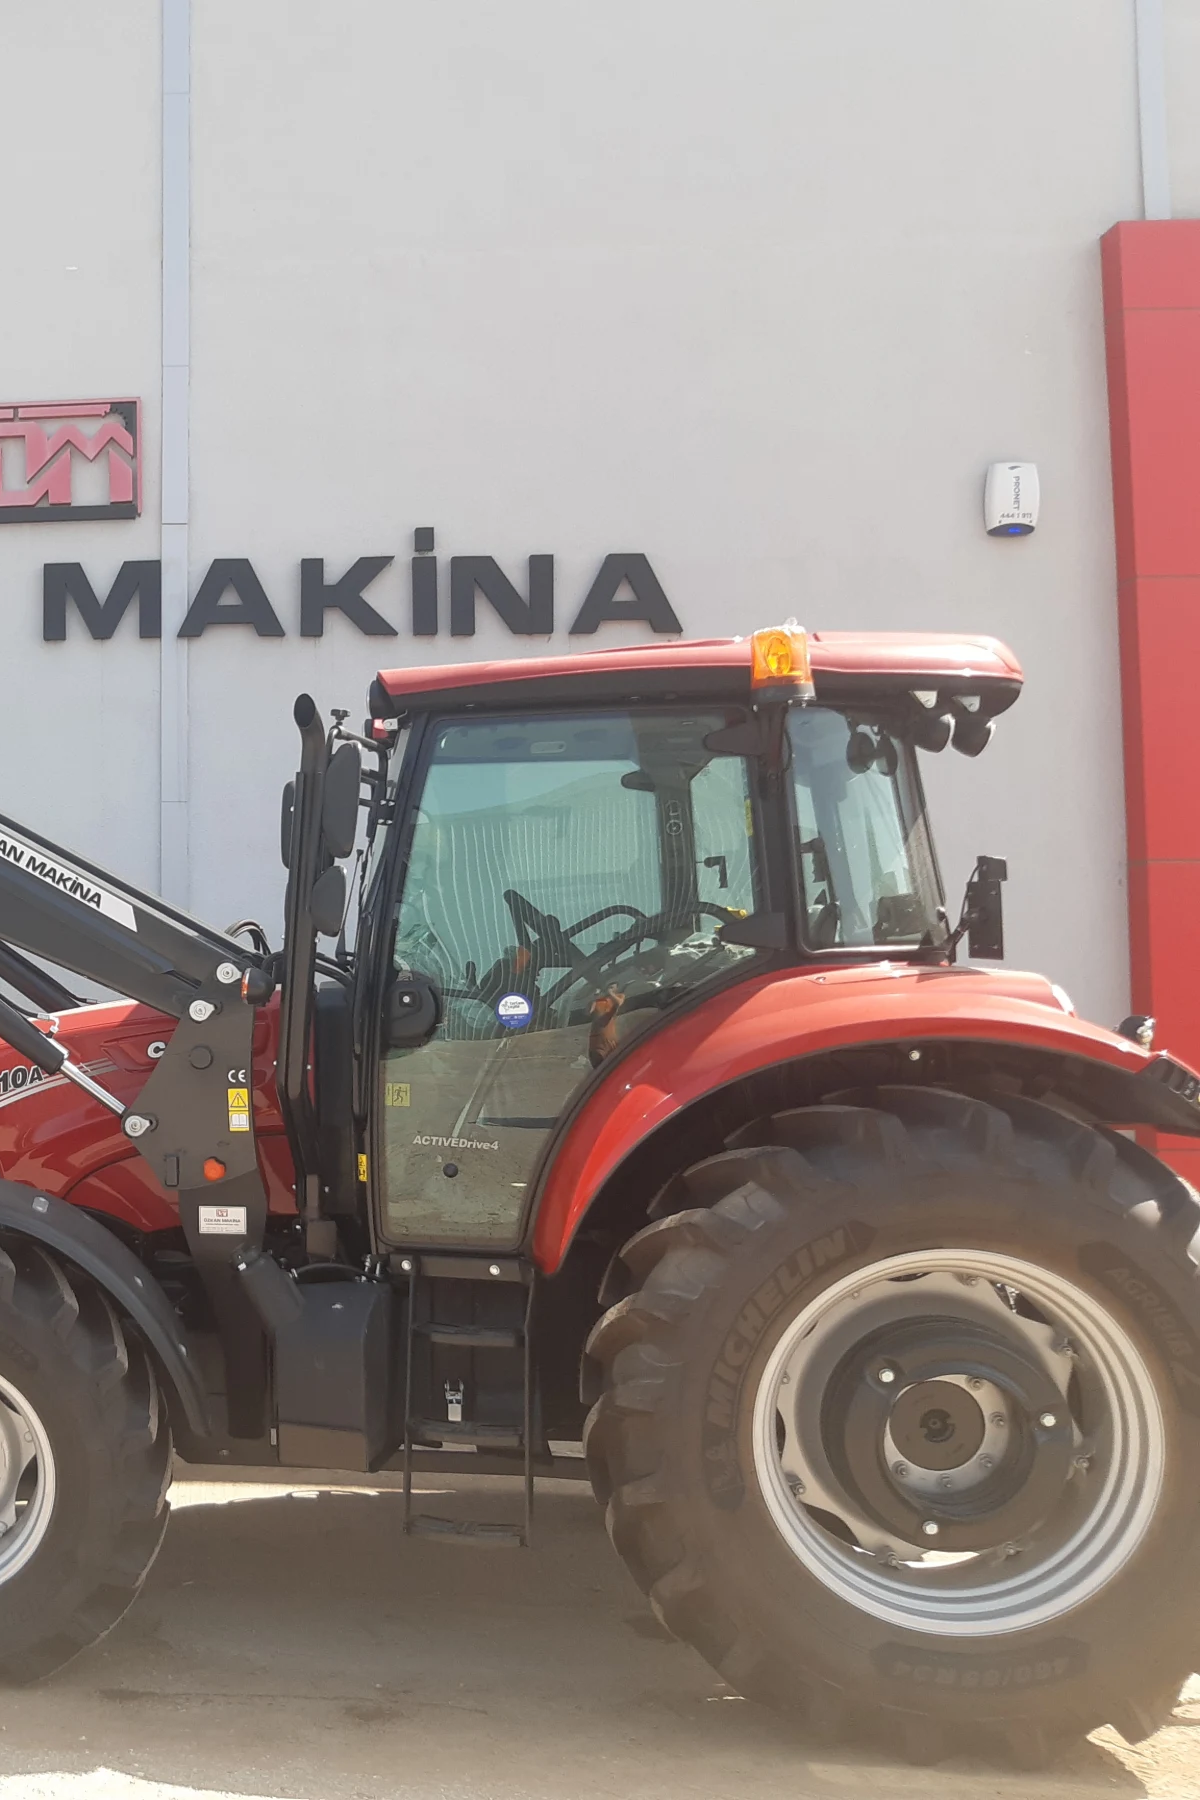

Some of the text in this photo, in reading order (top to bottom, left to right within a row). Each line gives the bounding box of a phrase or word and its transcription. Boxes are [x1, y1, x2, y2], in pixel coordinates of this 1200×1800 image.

[1013, 475, 1021, 511] PRONET
[43, 527, 683, 641] MAKİNA
[25, 855, 102, 909] MAKİNA
[412, 1135, 499, 1150] ACTIVEDrive4
[706, 1228, 846, 1428] MICHELIN
